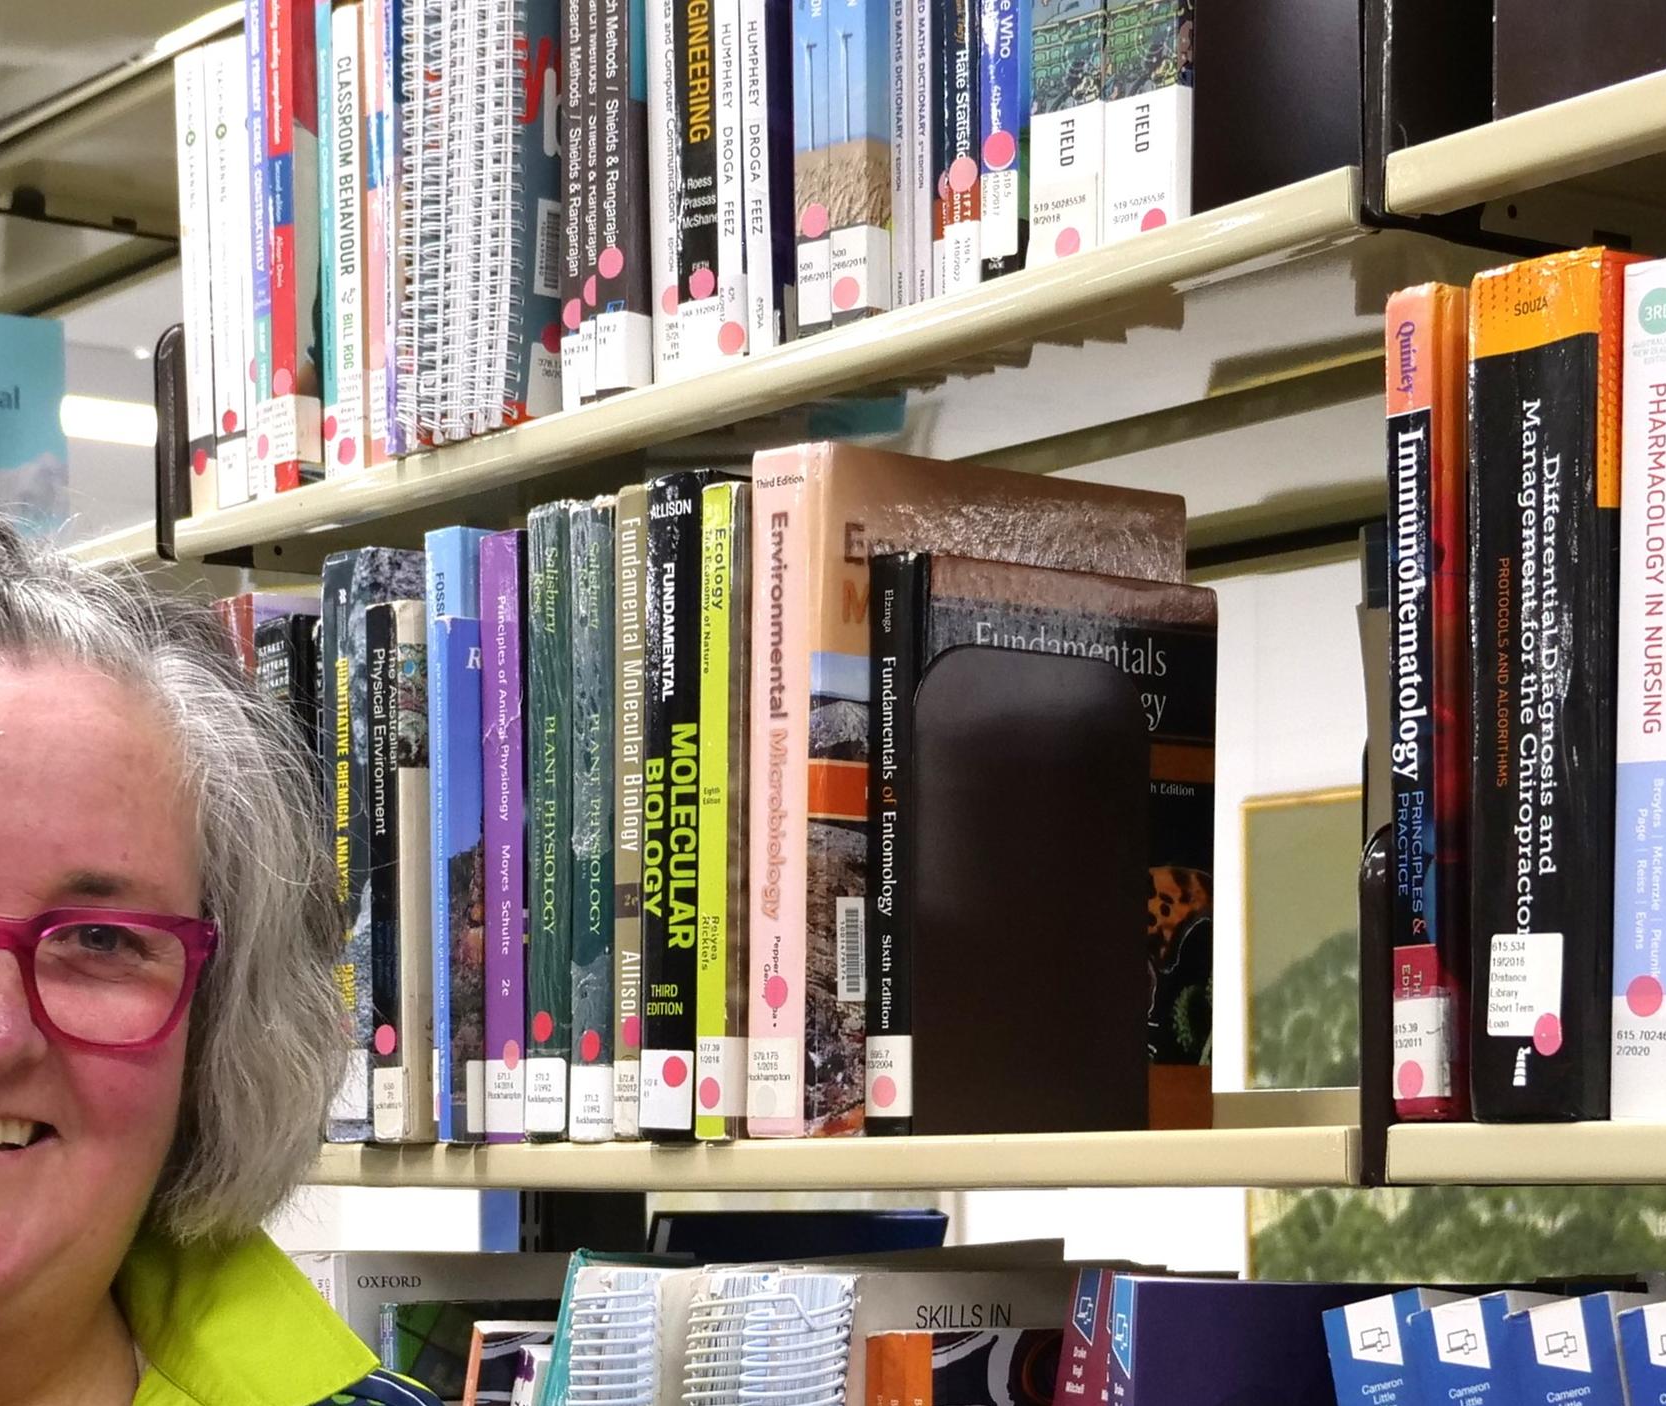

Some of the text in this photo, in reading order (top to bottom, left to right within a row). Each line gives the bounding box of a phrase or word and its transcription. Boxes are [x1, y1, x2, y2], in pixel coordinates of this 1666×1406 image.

[336, 56, 355, 276] CLASSROOM BEHAVIOUR
[566, 47, 581, 278] Methods Shields & Rangarajan
[663, 49, 676, 223] Computer Communications
[687, 177, 712, 190] Roess
[748, 20, 763, 236] HUMPHREY DROGA FEEZ
[1060, 119, 1074, 168] FIELD
[1034, 214, 1062, 225] 9/2018
[1392, 320, 1416, 395] Quinley
[1513, 298, 1548, 317] SOUZA
[650, 499, 691, 520] ALLISON
[712, 528, 726, 611] Ecology
[1518, 398, 1541, 612] Management
[1641, 382, 1666, 735] PHARMACOLOGY IN NURSING
[661, 562, 676, 702] FUNDAMENTAL
[1391, 426, 1428, 782] Immunohematology
[1520, 618, 1539, 661] for
[1538, 454, 1560, 877] Differential Diagnosis and
[372, 648, 387, 836] Physical Environment
[620, 516, 642, 853] Fundamental Molecular Biology
[760, 511, 791, 922] Environmental Microbiology
[878, 589, 896, 917] Elzinga Fundamentals of Entomology
[1520, 664, 1539, 724] the
[495, 596, 510, 956] Principles of Animal Physiology Moyes Schulte
[543, 715, 556, 935] PLANT PHYSIOLOGY
[644, 757, 664, 919] BIOLOGY
[667, 722, 698, 949] MOLECULAR
[1397, 792, 1409, 896] PRACTICE
[1410, 790, 1426, 935] PRINCIPLES &
[646, 1001, 683, 1016] EDITION
[650, 983, 679, 999] THIRD
[357, 1275, 422, 1289] OXFORD
[916, 1303, 1012, 1330] SKILLS IN
